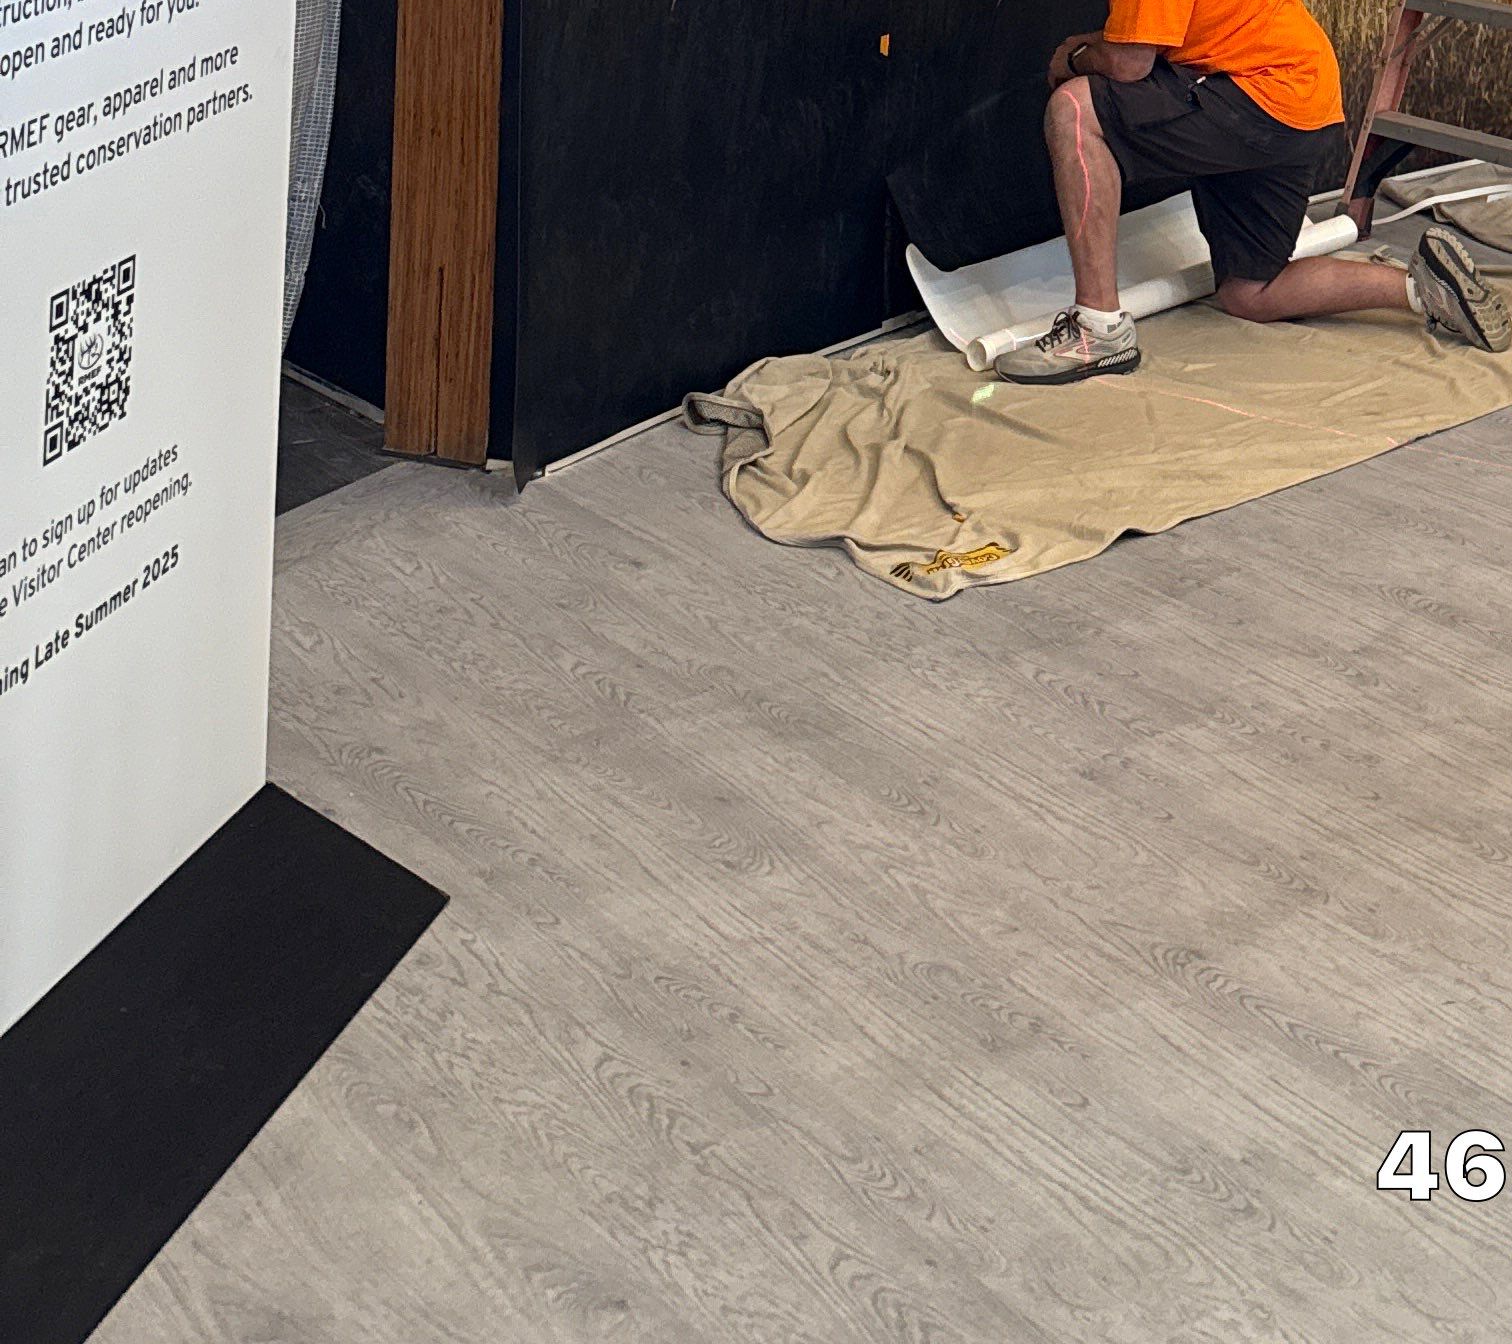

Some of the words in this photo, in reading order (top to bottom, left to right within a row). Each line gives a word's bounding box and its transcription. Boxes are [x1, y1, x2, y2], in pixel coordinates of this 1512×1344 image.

[0, 40, 45, 81] open
[50, 21, 84, 60] and
[87, 6, 137, 45] ready
[140, 0, 164, 27] for
[54, 101, 99, 144] gear,
[102, 68, 164, 120] apparel
[167, 55, 197, 91] and
[199, 45, 239, 78] more
[4, 152, 72, 207] trusted
[75, 112, 183, 175] conservation
[187, 82, 253, 133] partners.
[12, 555, 64, 608] Visitor
[67, 519, 118, 570] Center
[120, 472, 193, 535] reopening.
[21, 537, 38, 563] to
[42, 513, 73, 546] sign
[77, 498, 96, 525] up
[99, 480, 121, 510] for
[123, 443, 178, 494] updates
[34, 627, 71, 670] Late
[74, 576, 139, 639] Summer
[141, 543, 180, 591] 2025
